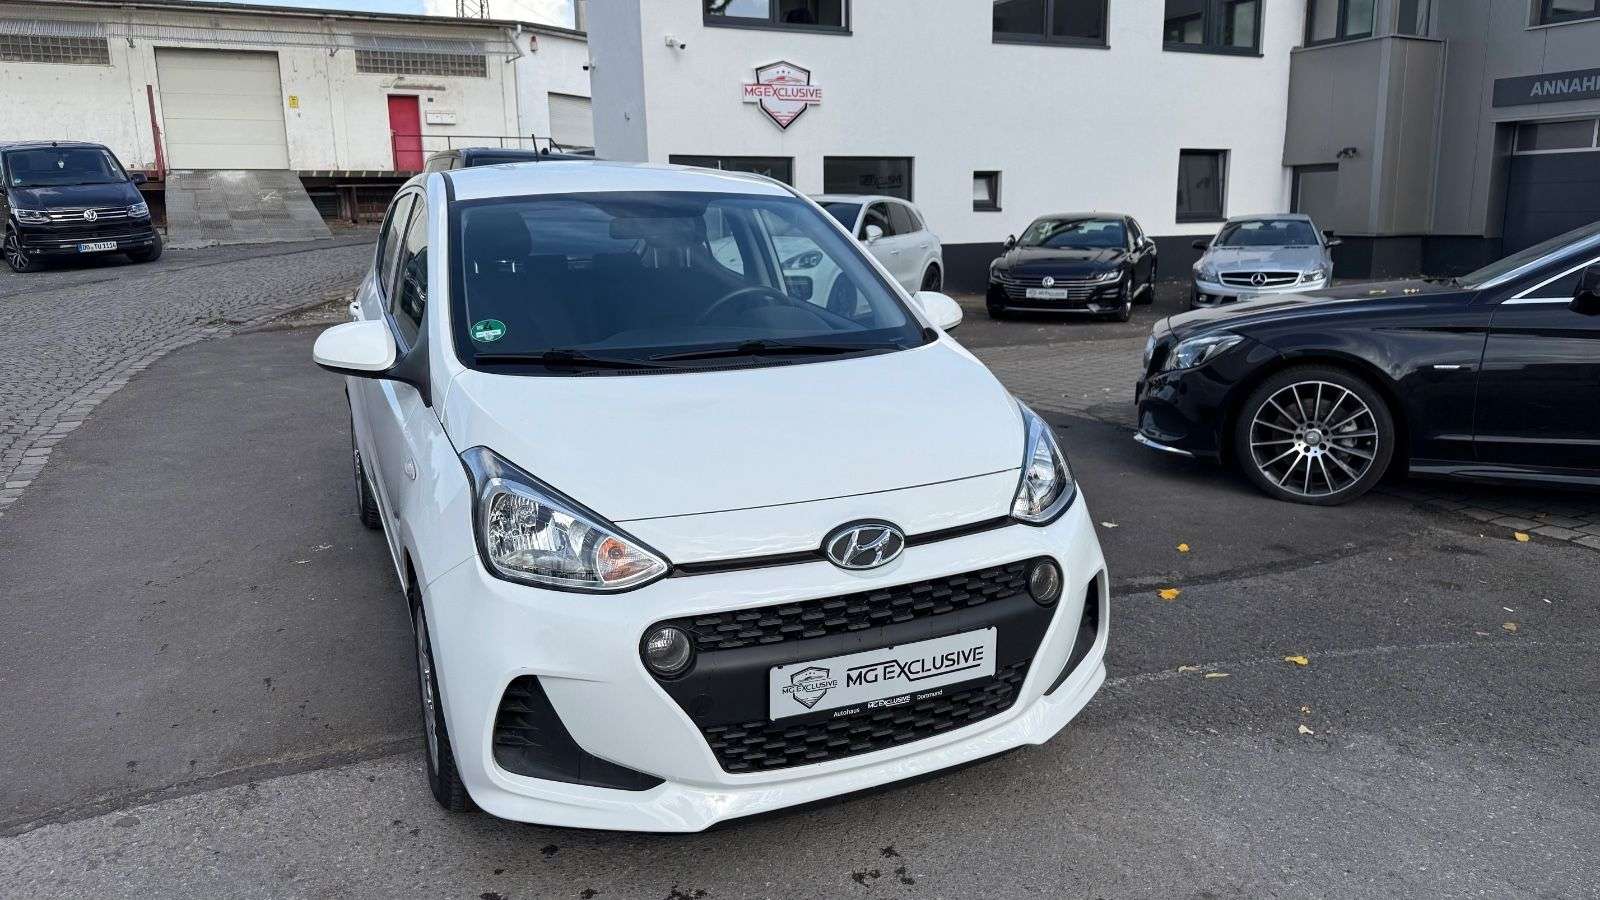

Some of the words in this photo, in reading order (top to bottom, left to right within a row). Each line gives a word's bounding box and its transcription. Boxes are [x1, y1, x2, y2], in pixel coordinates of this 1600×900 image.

[1530, 75, 1600, 96] ANNAH
[846, 668, 878, 687] MG
[884, 646, 984, 680] EXCLUSIVE
[796, 680, 838, 693] EXCLUSIVE
[833, 707, 860, 718] Autohaus
